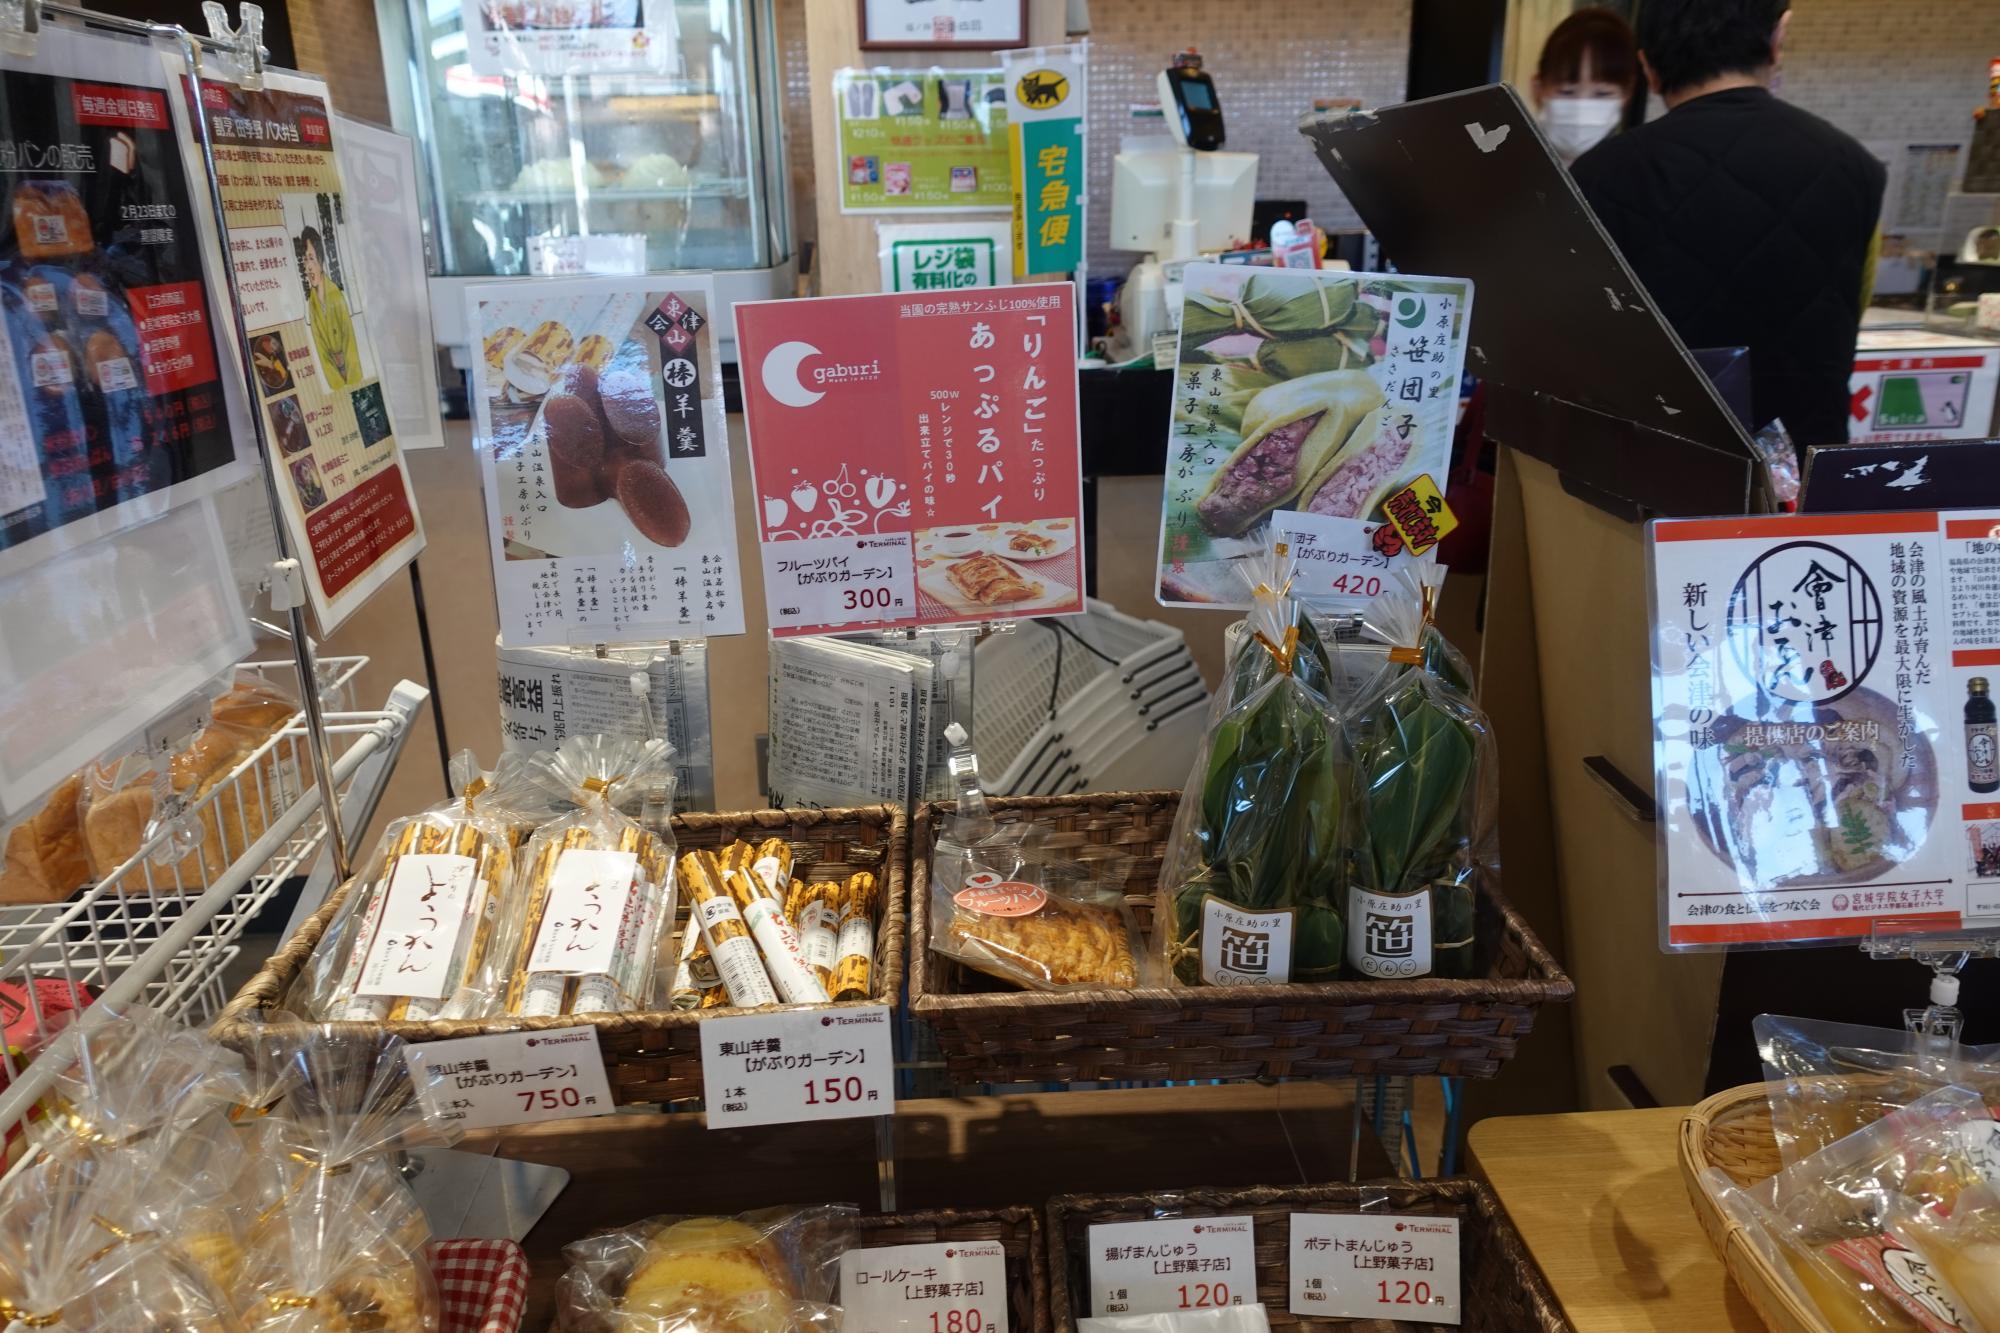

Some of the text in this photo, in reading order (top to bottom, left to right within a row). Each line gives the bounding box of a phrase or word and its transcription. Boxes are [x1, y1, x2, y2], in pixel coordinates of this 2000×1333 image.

[1037, 145, 1072, 247] 宅急便
[912, 248, 976, 271] レジ袋
[911, 272, 977, 289] 有料化の
[900, 296, 1061, 317] 当園の完熟サンふじ100%使用
[1427, 297, 1452, 399] 小原庄助の里
[813, 360, 881, 384] gaburi
[1381, 345, 1400, 427] ささだんご
[1396, 337, 1430, 439] 笹団子
[969, 322, 1004, 519] あっぷるパイ
[1203, 367, 1222, 466] 東山温泉入口
[1176, 371, 1201, 529] 菓子工房がぶり
[1296, 546, 1391, 570] 【がぶりガーデン】
[1966, 541, 2000, 554] 「地の
[776, 556, 849, 573] フルーツパイ
[646, 555, 658, 601] 昔ながらの
[701, 555, 716, 622] 東山温泉名物
[712, 555, 727, 609] 会津若松市
[796, 567, 894, 587] 【がぶりガーデン】
[1332, 573, 1381, 597] 420
[609, 578, 622, 632] いることから
[842, 587, 904, 611] 300 円
[525, 612, 534, 638] います
[1908, 541, 1932, 685] 会津の風土が育んだ
[1682, 581, 1715, 751] 新しい会津の味
[1889, 541, 1918, 769] 地域の資源を最大限に生かした
[1743, 721, 1881, 747] 提供店のご案内
[1355, 897, 1423, 911] 小原庄助の里
[1214, 909, 1281, 928] 小原庄助の里
[836, 1016, 884, 1027] TERMINAL
[541, 1036, 591, 1047] TERMINAL
[745, 1048, 866, 1073] 【がぶりガーデン】
[455, 1064, 578, 1090] 【がぶりガーデン】
[517, 1086, 581, 1112] 750
[804, 1076, 879, 1105] 150 円
[1206, 1225, 1249, 1234] TERMINAL
[1409, 1224, 1453, 1234] TERMINAL
[959, 1249, 1001, 1258] TERMINAL
[1105, 1243, 1199, 1261] 揚げまんじゅう
[1303, 1238, 1414, 1254] ポテトまんじゅう
[1153, 1257, 1232, 1275] 【上野菓子店】
[1353, 1255, 1435, 1272] 【上野菓子店】
[856, 1267, 938, 1285] ロールケーキ
[904, 1281, 984, 1300] 【上野菓子店】
[1177, 1282, 1243, 1308] 120 円
[1377, 1279, 1445, 1306] 120 円
[929, 1308, 982, 1333] 180
